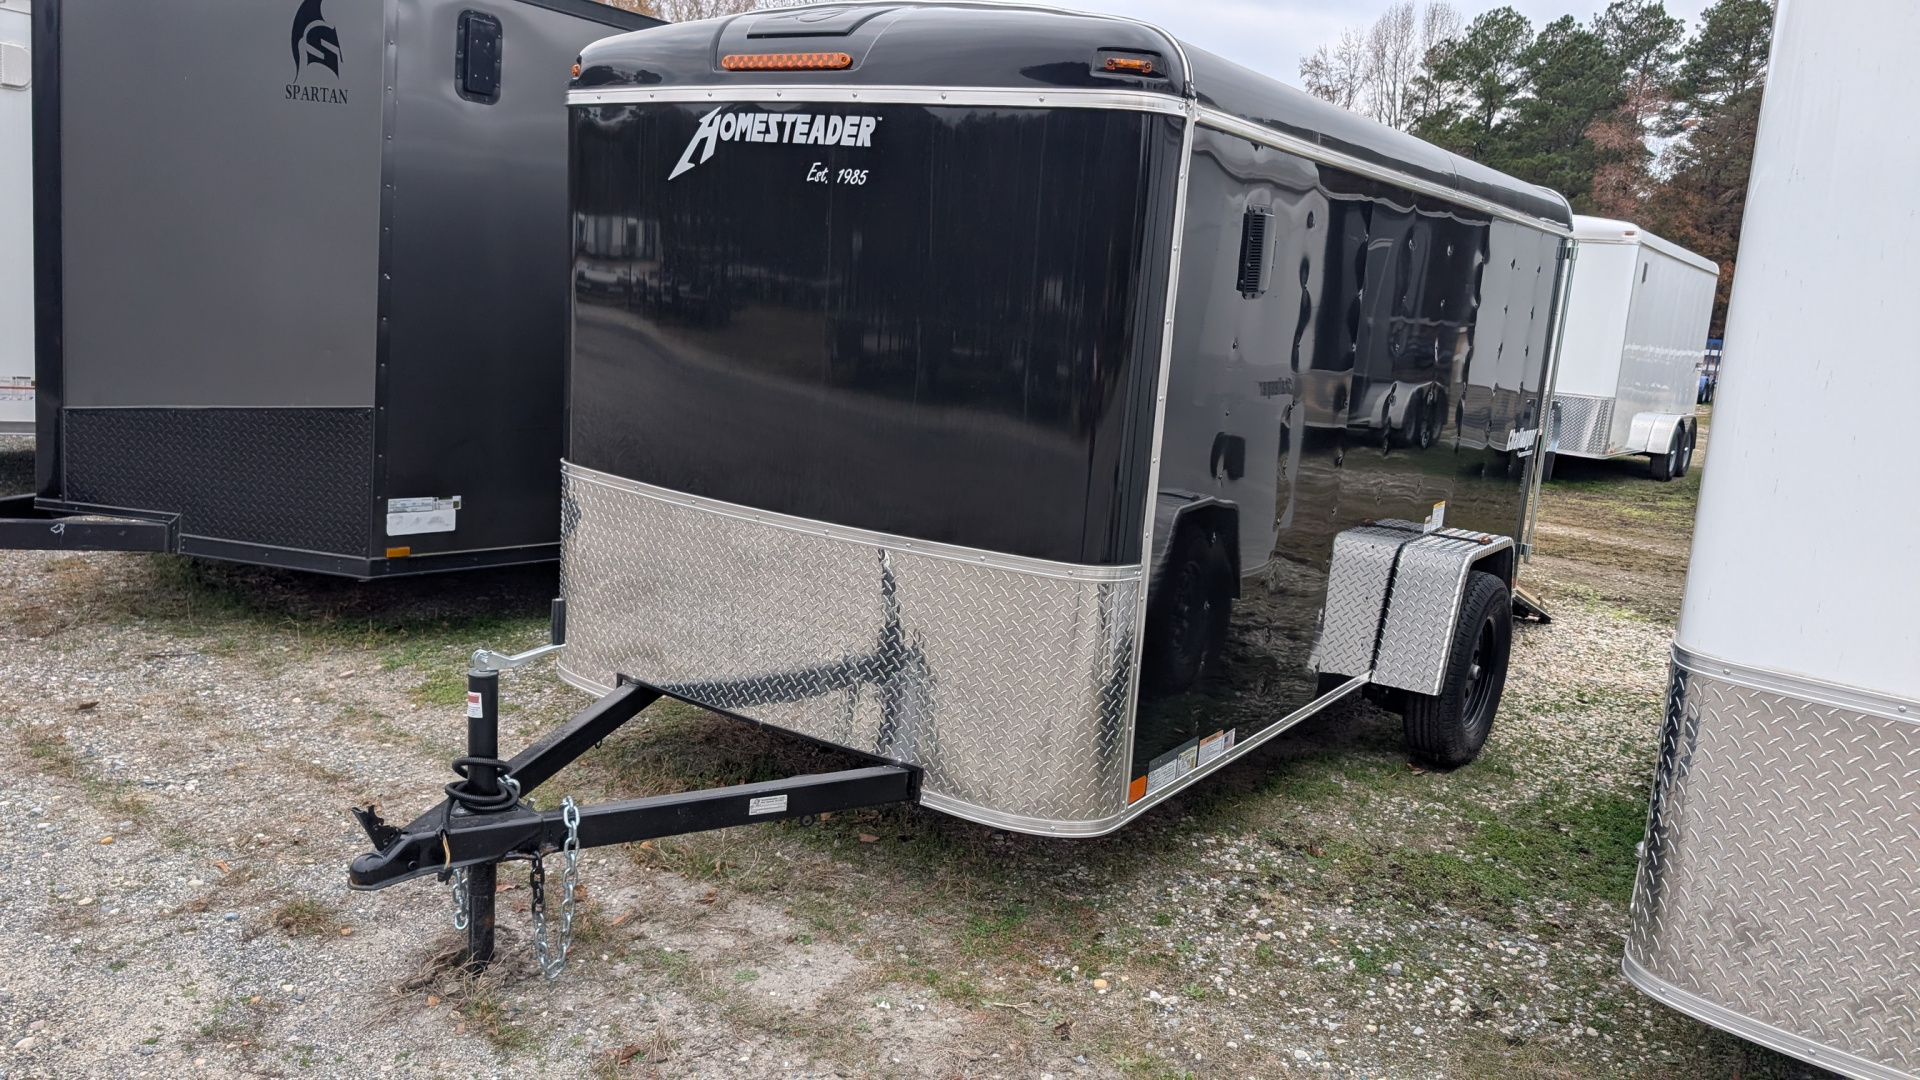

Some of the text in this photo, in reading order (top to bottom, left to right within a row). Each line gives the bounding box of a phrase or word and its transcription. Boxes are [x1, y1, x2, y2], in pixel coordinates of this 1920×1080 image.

[285, 84, 348, 104] SPARTAN
[668, 106, 876, 180] HOMESTEADER
[837, 169, 869, 185] 1985
